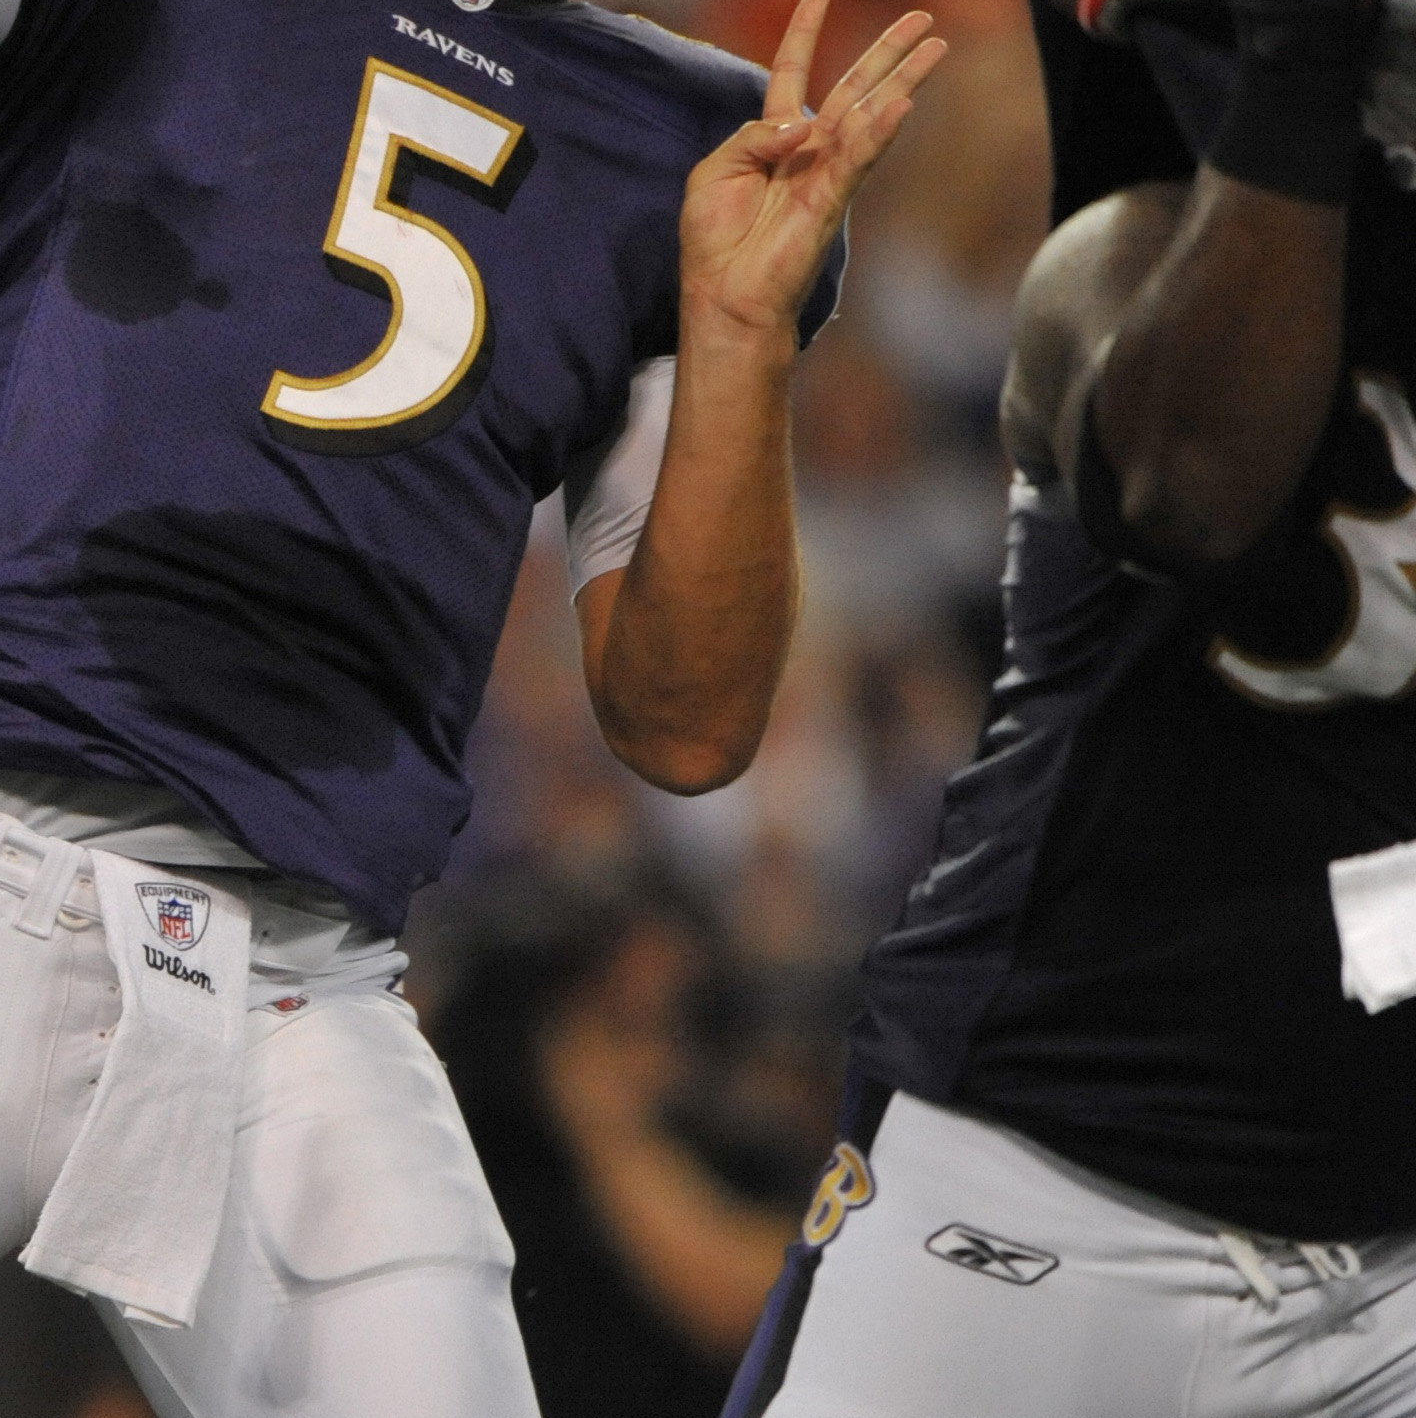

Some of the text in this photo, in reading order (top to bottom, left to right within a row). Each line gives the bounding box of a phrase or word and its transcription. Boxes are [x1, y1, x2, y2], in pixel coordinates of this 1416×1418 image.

[391, 13, 514, 87] RAVENS
[260, 56, 525, 430] 5
[140, 885, 207, 906] EQUIPMENT
[161, 915, 191, 940] NFL
[142, 944, 212, 991] Wilson
[803, 1143, 871, 1247] B
